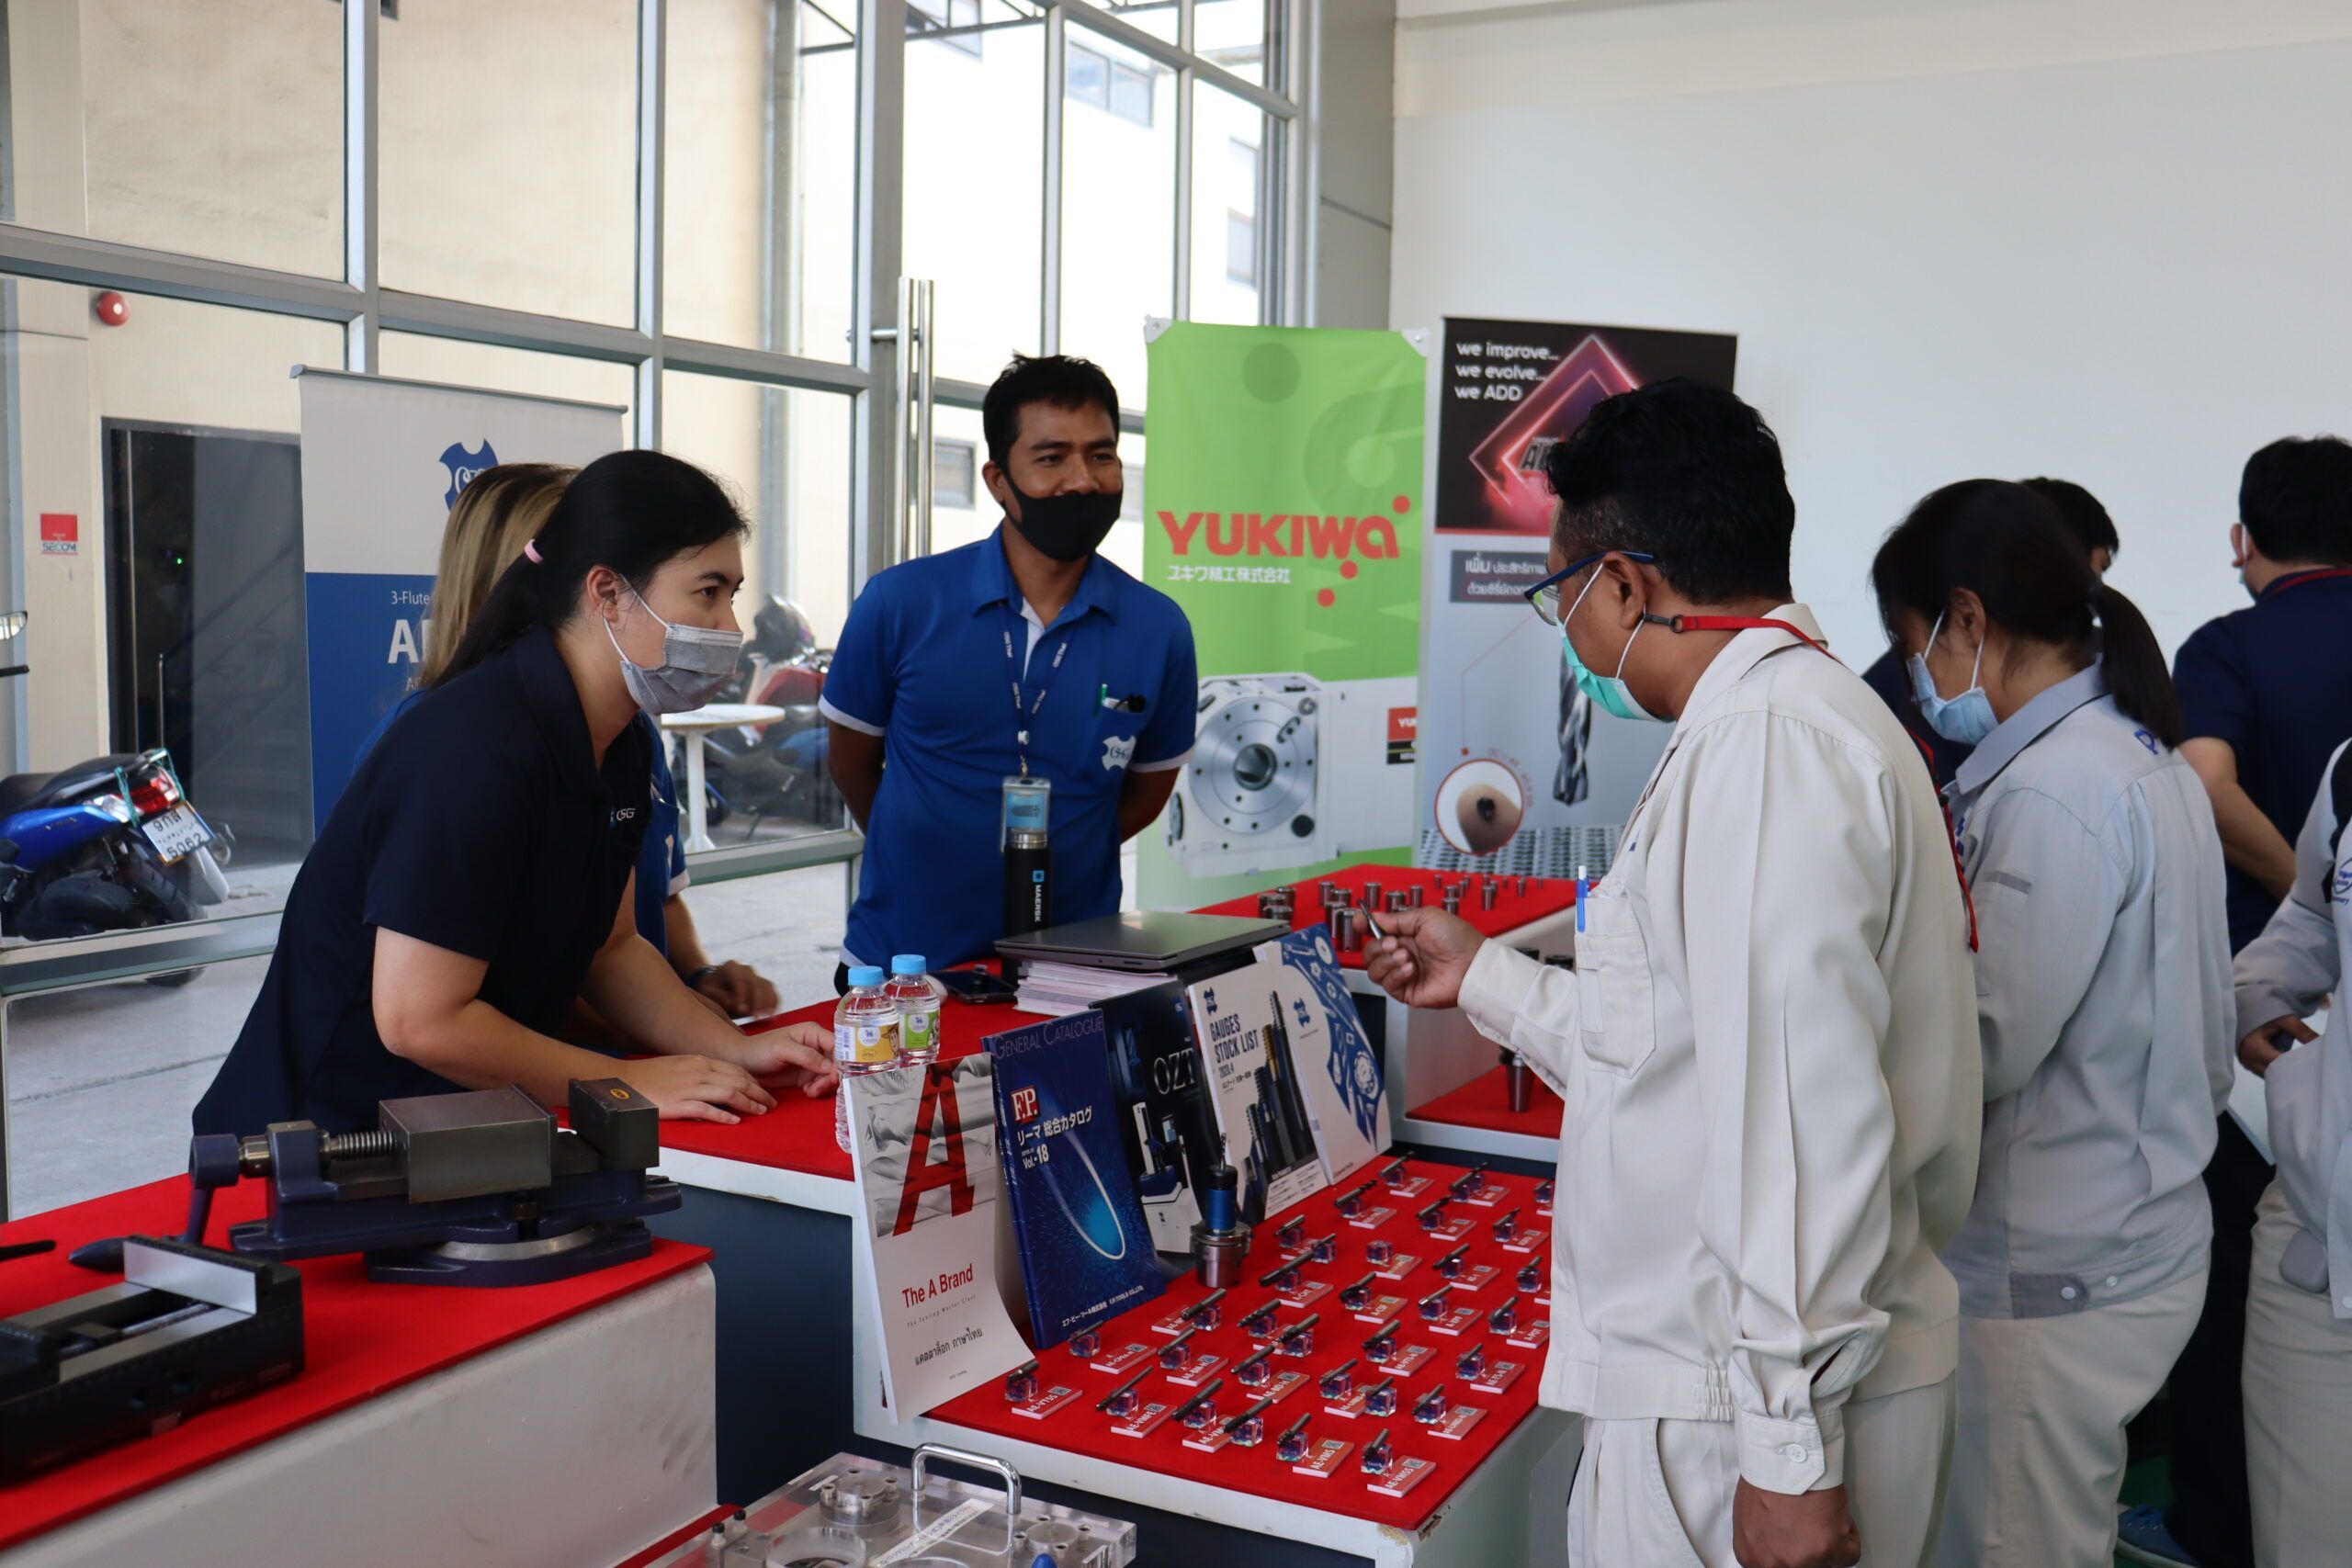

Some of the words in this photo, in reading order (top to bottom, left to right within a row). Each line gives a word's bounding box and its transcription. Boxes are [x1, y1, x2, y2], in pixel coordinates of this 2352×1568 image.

[1456, 343, 1482, 356] we
[1486, 342, 1560, 361] improve...
[1455, 366, 1481, 378] we
[1454, 387, 1480, 400] we
[1484, 386, 1523, 401] ADD
[42, 542, 76, 552] SECOM
[390, 591, 431, 605] 3-Flute
[993, 1034, 1041, 1060] GENERAL
[1044, 1015, 1103, 1046] CATALOGUE
[1209, 1013, 1241, 1042] GAUGES
[1214, 1037, 1241, 1064] STOCK
[1239, 1029, 1260, 1055] LIST
[1012, 1088, 1039, 1122] F.P.
[1017, 1126, 1041, 1146] リーマ
[1043, 1105, 1092, 1138] 総合カタログ
[902, 1286, 926, 1309] The
[928, 1278, 938, 1299] A
[939, 1263, 974, 1294] Brand
[952, 1326, 983, 1349] ภาษาไทย
[1026, 1394, 1058, 1413] AE-VTSS
[1310, 1449, 1336, 1470] AE-VMS
[1385, 1468, 1414, 1489] AE-VMSS
